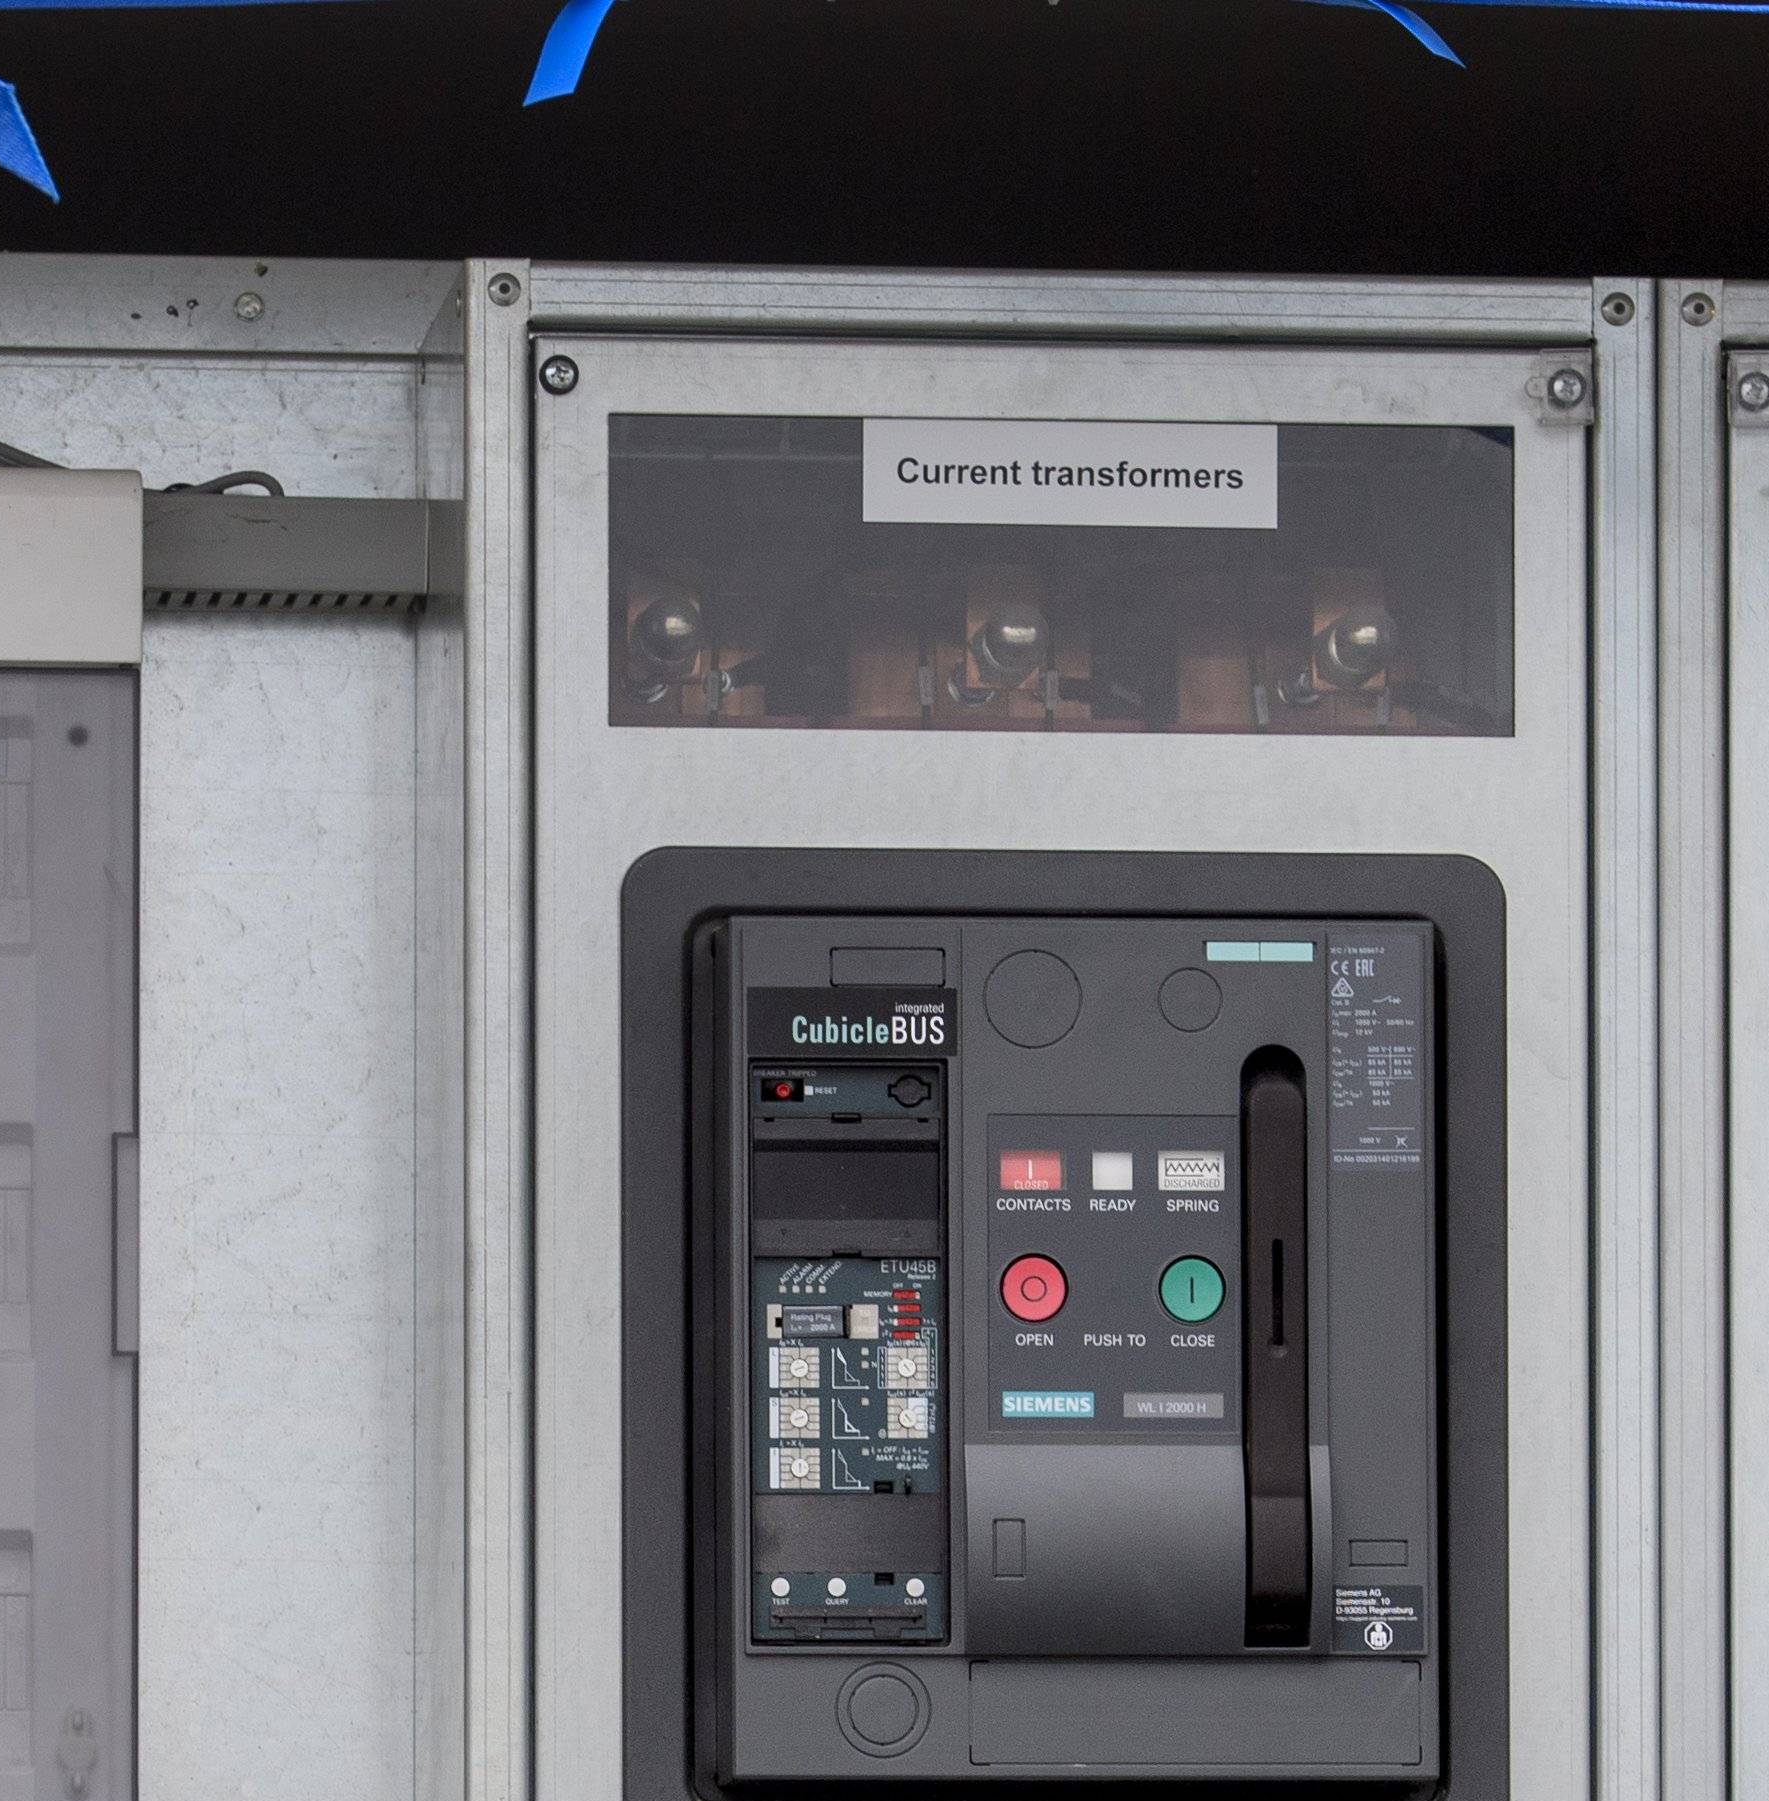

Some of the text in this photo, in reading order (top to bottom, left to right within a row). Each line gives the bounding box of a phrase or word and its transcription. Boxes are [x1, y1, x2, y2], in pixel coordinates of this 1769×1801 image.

[897, 456, 1244, 491] Current transformers
[895, 1002, 944, 1016] integrated
[792, 1015, 945, 1045] CubicleBUS
[814, 1086, 838, 1095] RESET
[1014, 1180, 1049, 1190] CLOSED
[1163, 1179, 1221, 1188] DISCHARGED
[996, 1198, 1072, 1212] CONTACTS
[1089, 1199, 1137, 1212] READY
[1166, 1199, 1220, 1213] SPRING
[881, 1260, 936, 1273] ETU45B
[1015, 1334, 1054, 1347] OPEN
[1084, 1335, 1146, 1347] PUSH TO
[1170, 1335, 1216, 1348] CLOSE
[1003, 1398, 1092, 1413] SIEMENS
[1137, 1402, 1157, 1413] WL
[1166, 1402, 1195, 1413] 2000
[1197, 1402, 1207, 1413] H
[772, 1598, 790, 1606] TEST
[825, 1598, 849, 1606] QUERY
[904, 1598, 928, 1606] CLEAR
